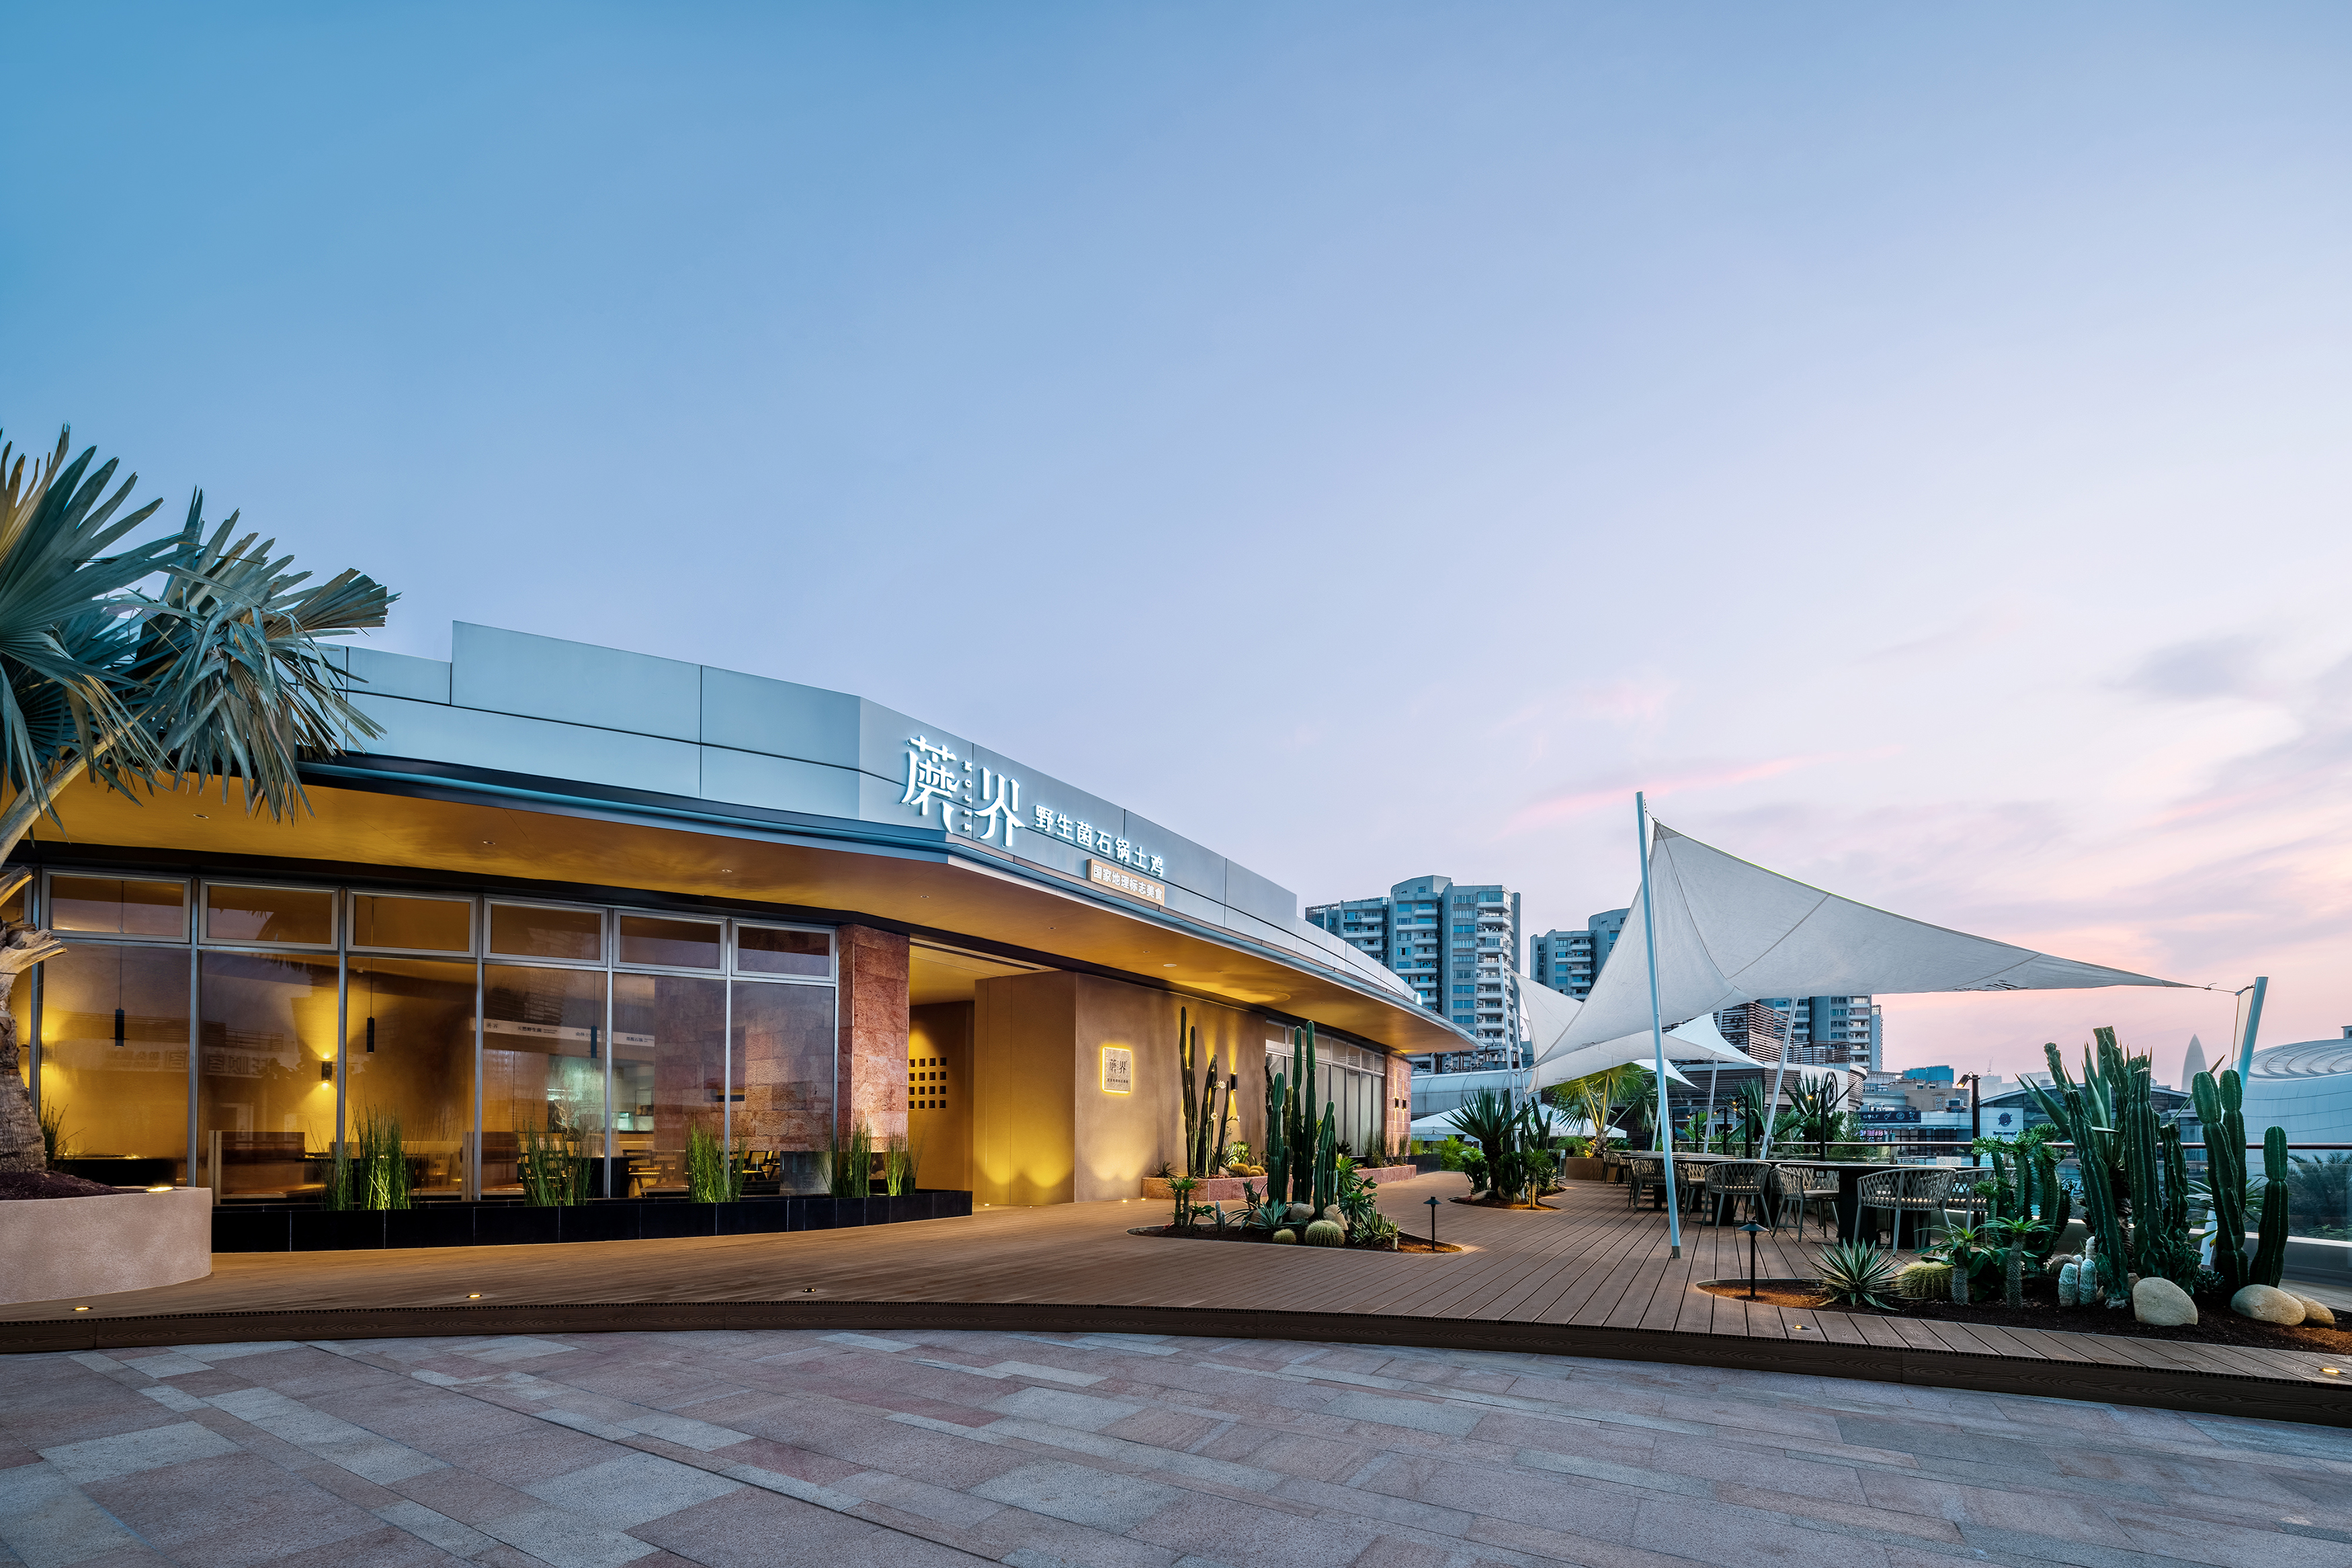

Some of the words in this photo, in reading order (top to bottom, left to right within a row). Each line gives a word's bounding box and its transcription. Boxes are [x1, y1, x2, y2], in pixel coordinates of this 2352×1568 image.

[1034, 803, 1163, 877] 野生菌石锅土鸡
[1093, 864, 1163, 896] 国家地理标志美食
